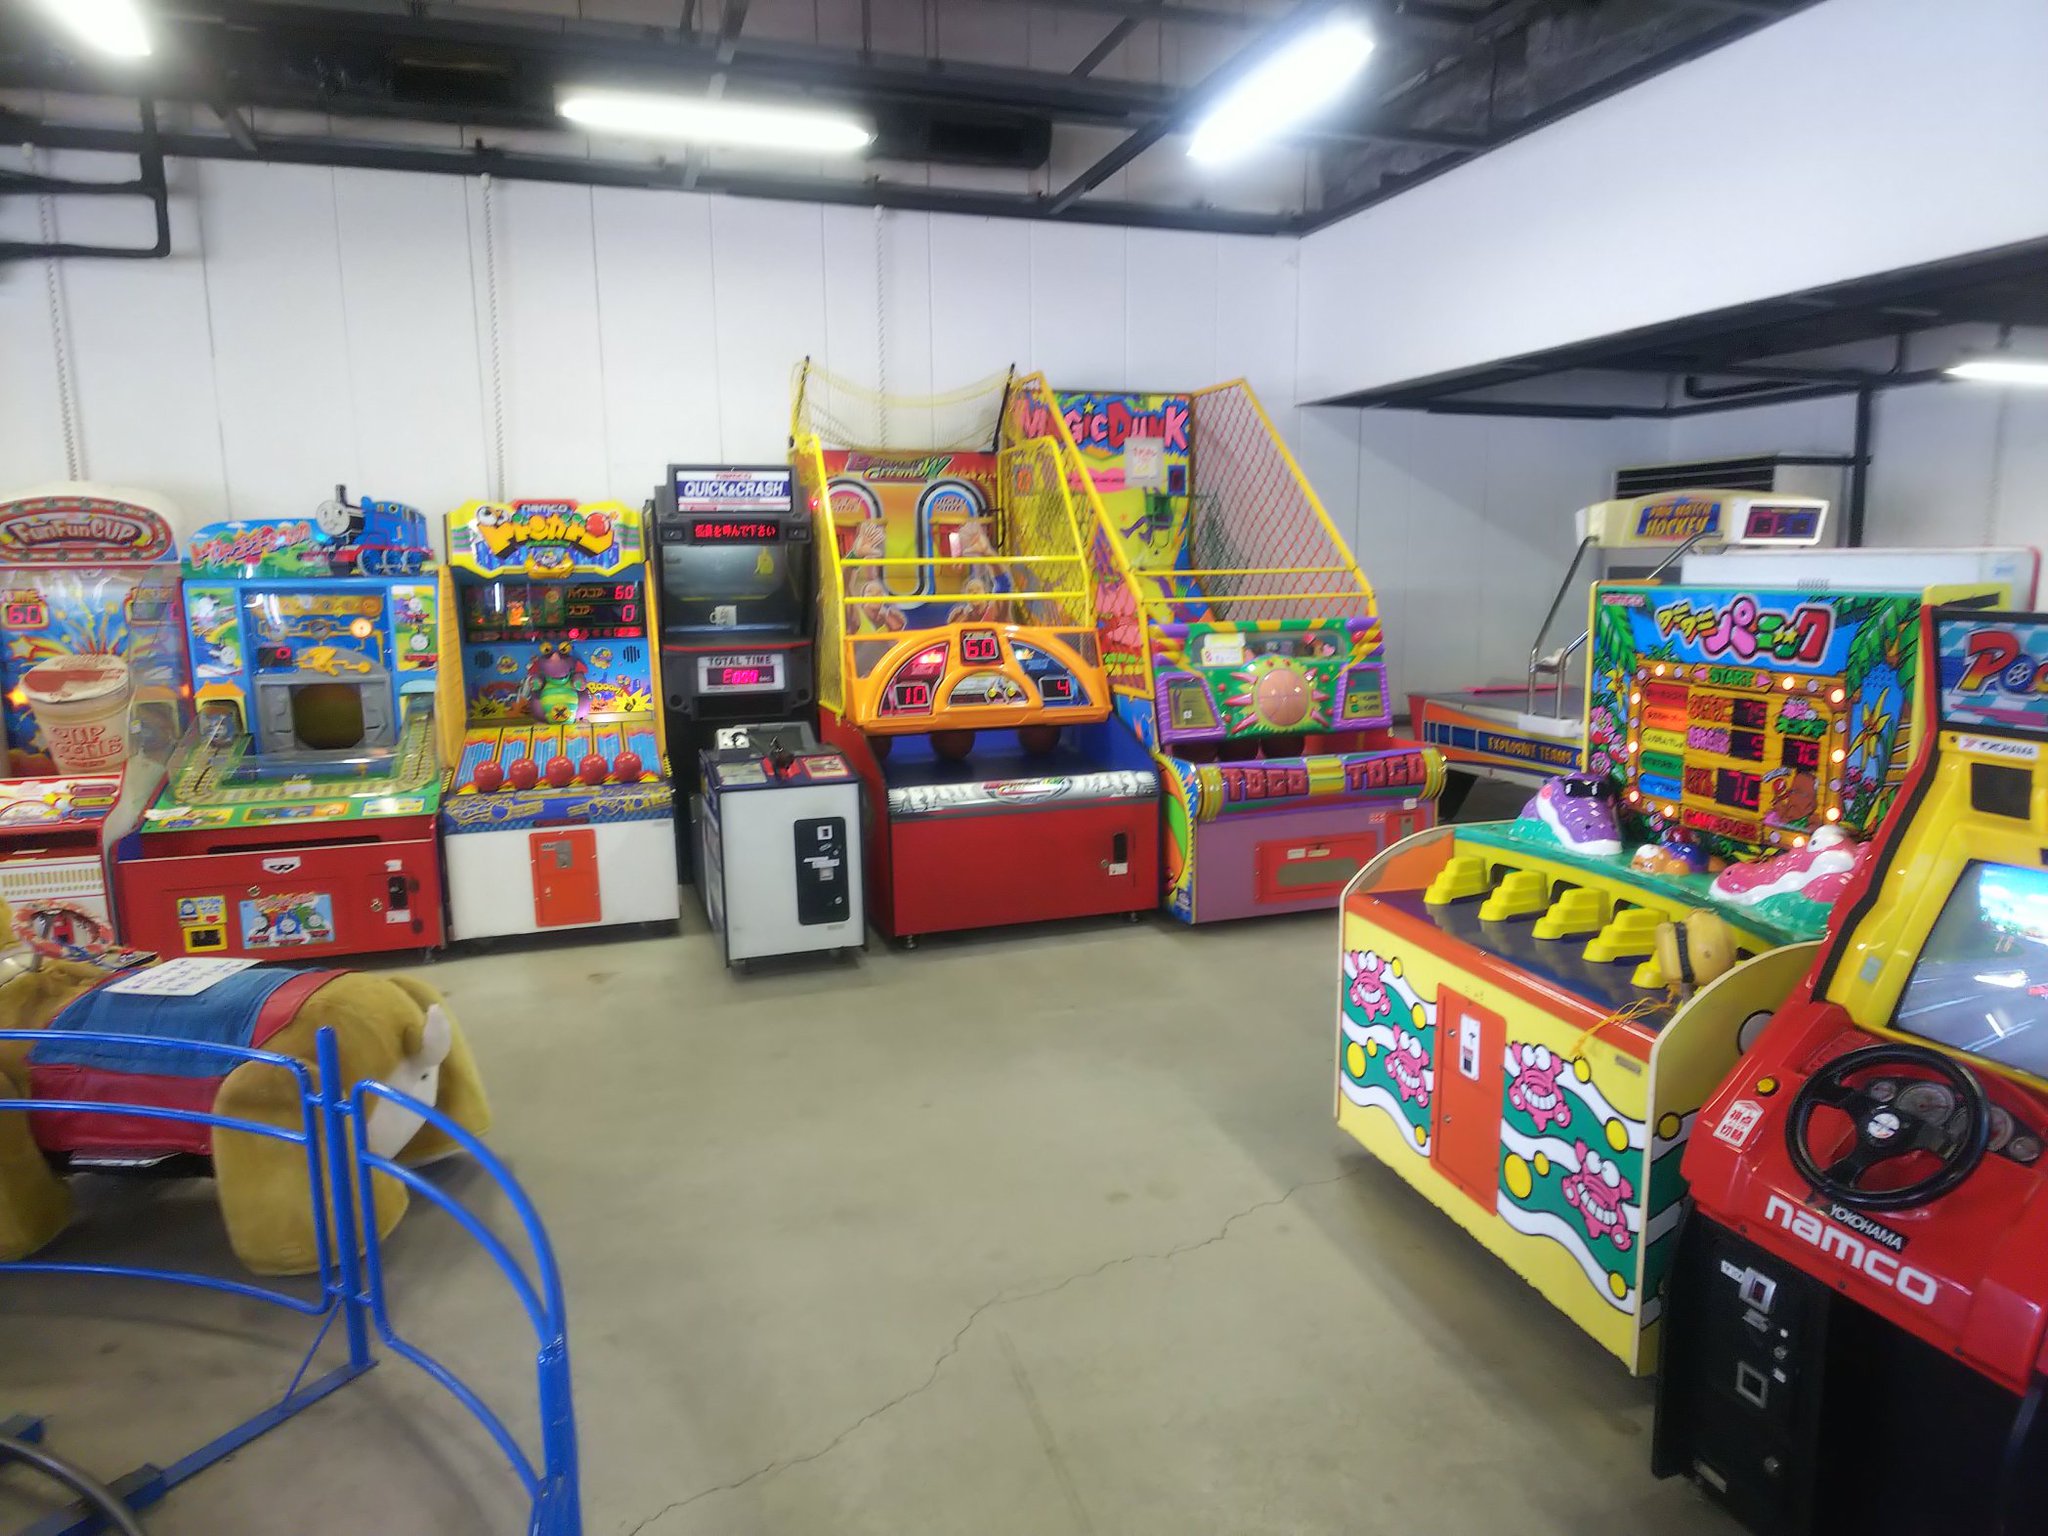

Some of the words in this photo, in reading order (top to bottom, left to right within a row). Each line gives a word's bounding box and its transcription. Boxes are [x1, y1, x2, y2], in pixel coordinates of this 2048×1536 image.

[683, 480, 785, 498] QUICK&CRASH
[520, 503, 569, 514] namco
[1645, 516, 1710, 537] HOCKEY
[613, 584, 635, 600] 60
[621, 603, 636, 623] 0
[965, 638, 995, 658] 60
[706, 656, 742, 667] TOTAL
[745, 654, 772, 666] TIME
[1708, 667, 1756, 687] START
[905, 685, 928, 705] 10
[1056, 680, 1071, 696] 4
[1829, 1203, 1904, 1251] YOKOHAMA
[1763, 1194, 1938, 1306] namco
